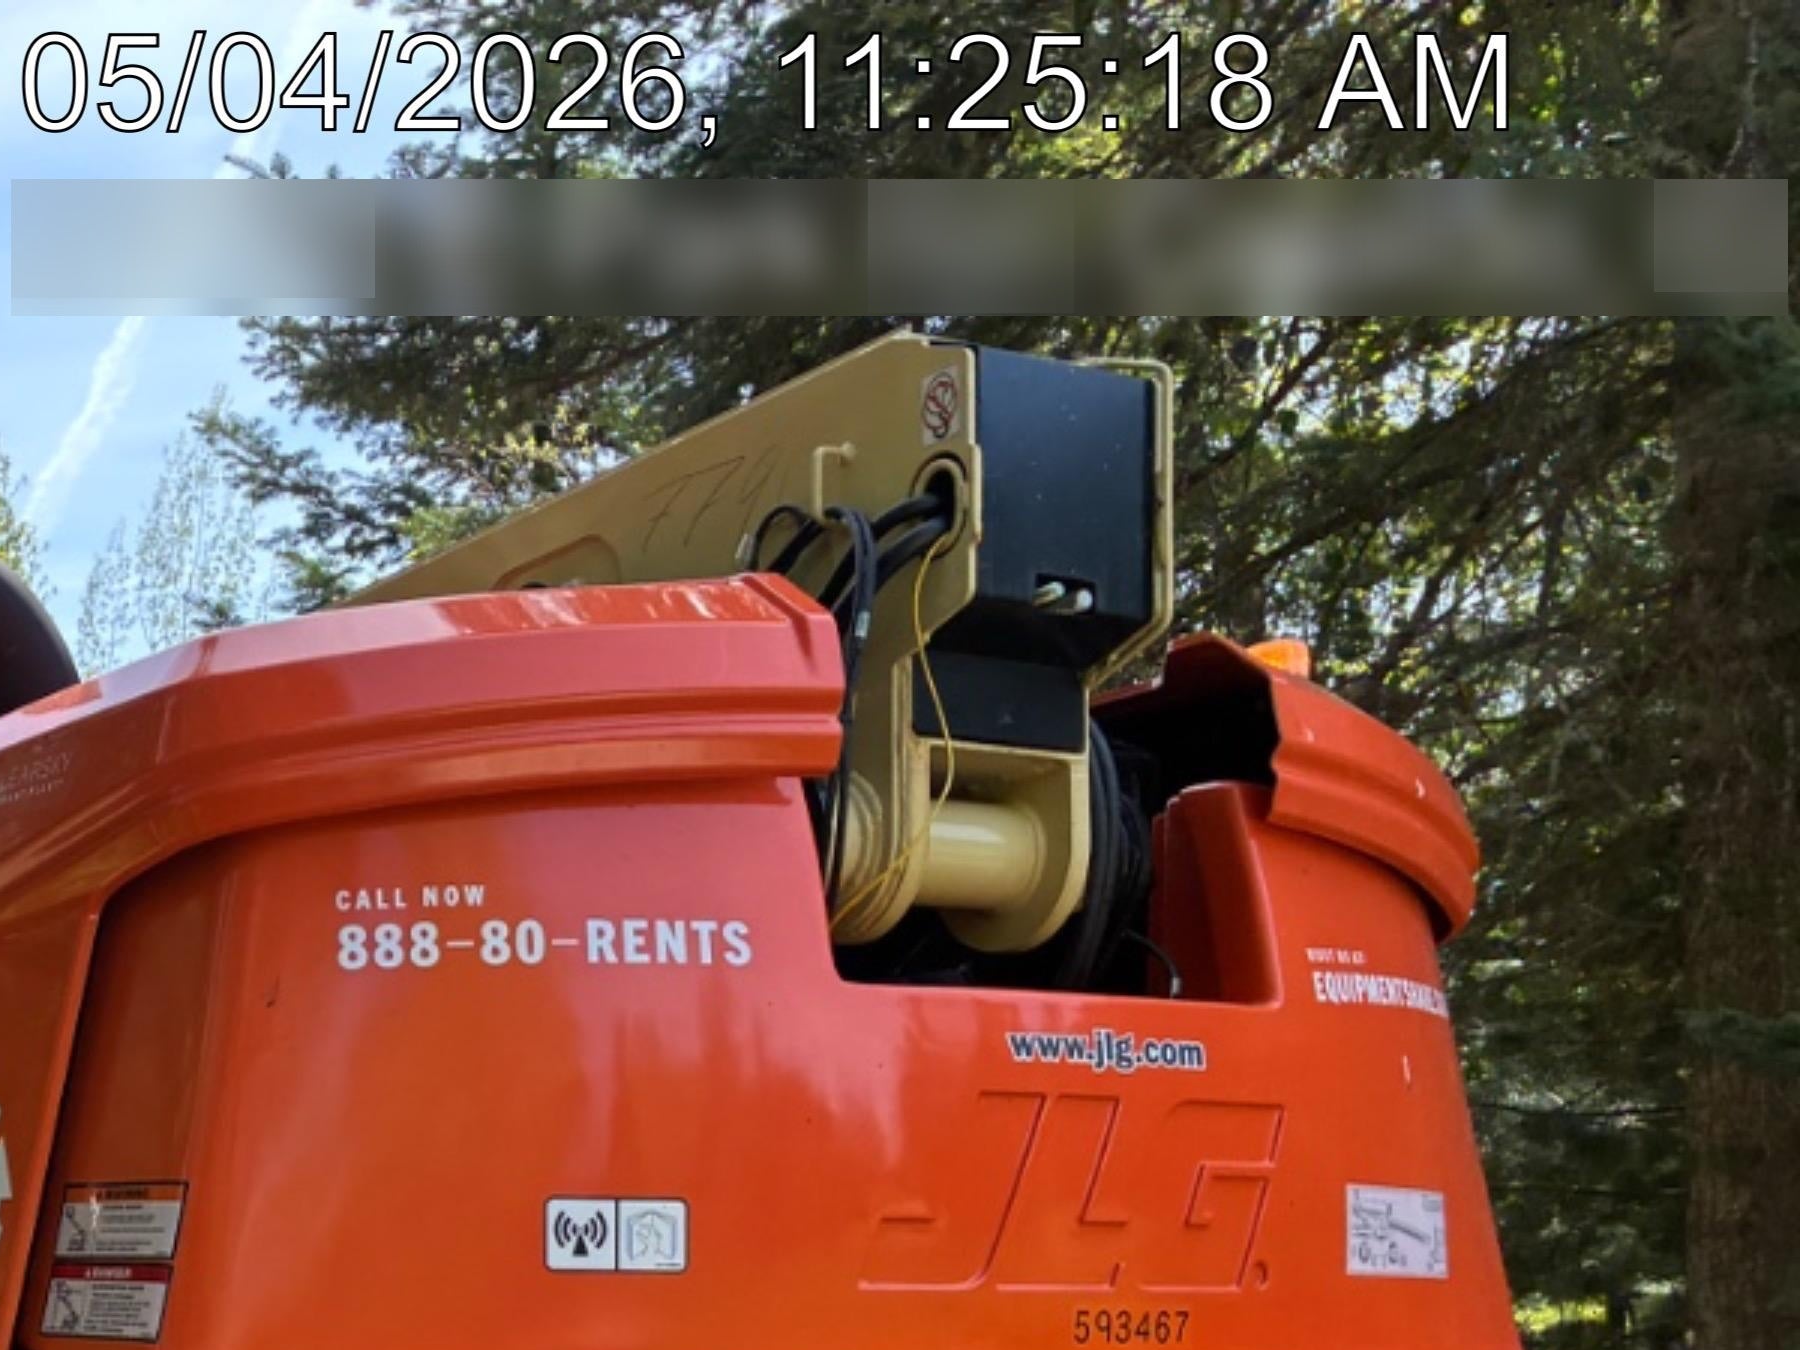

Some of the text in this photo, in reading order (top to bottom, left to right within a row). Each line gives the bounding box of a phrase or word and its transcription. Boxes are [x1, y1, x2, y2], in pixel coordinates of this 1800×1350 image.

[335, 884, 486, 910] CALL NOW
[337, 919, 753, 970] 888-80-RENTS
[1007, 1028, 1205, 1072] www.jlg.com
[858, 1090, 1285, 1292] JLG
[1073, 1309, 1190, 1345] 593467
